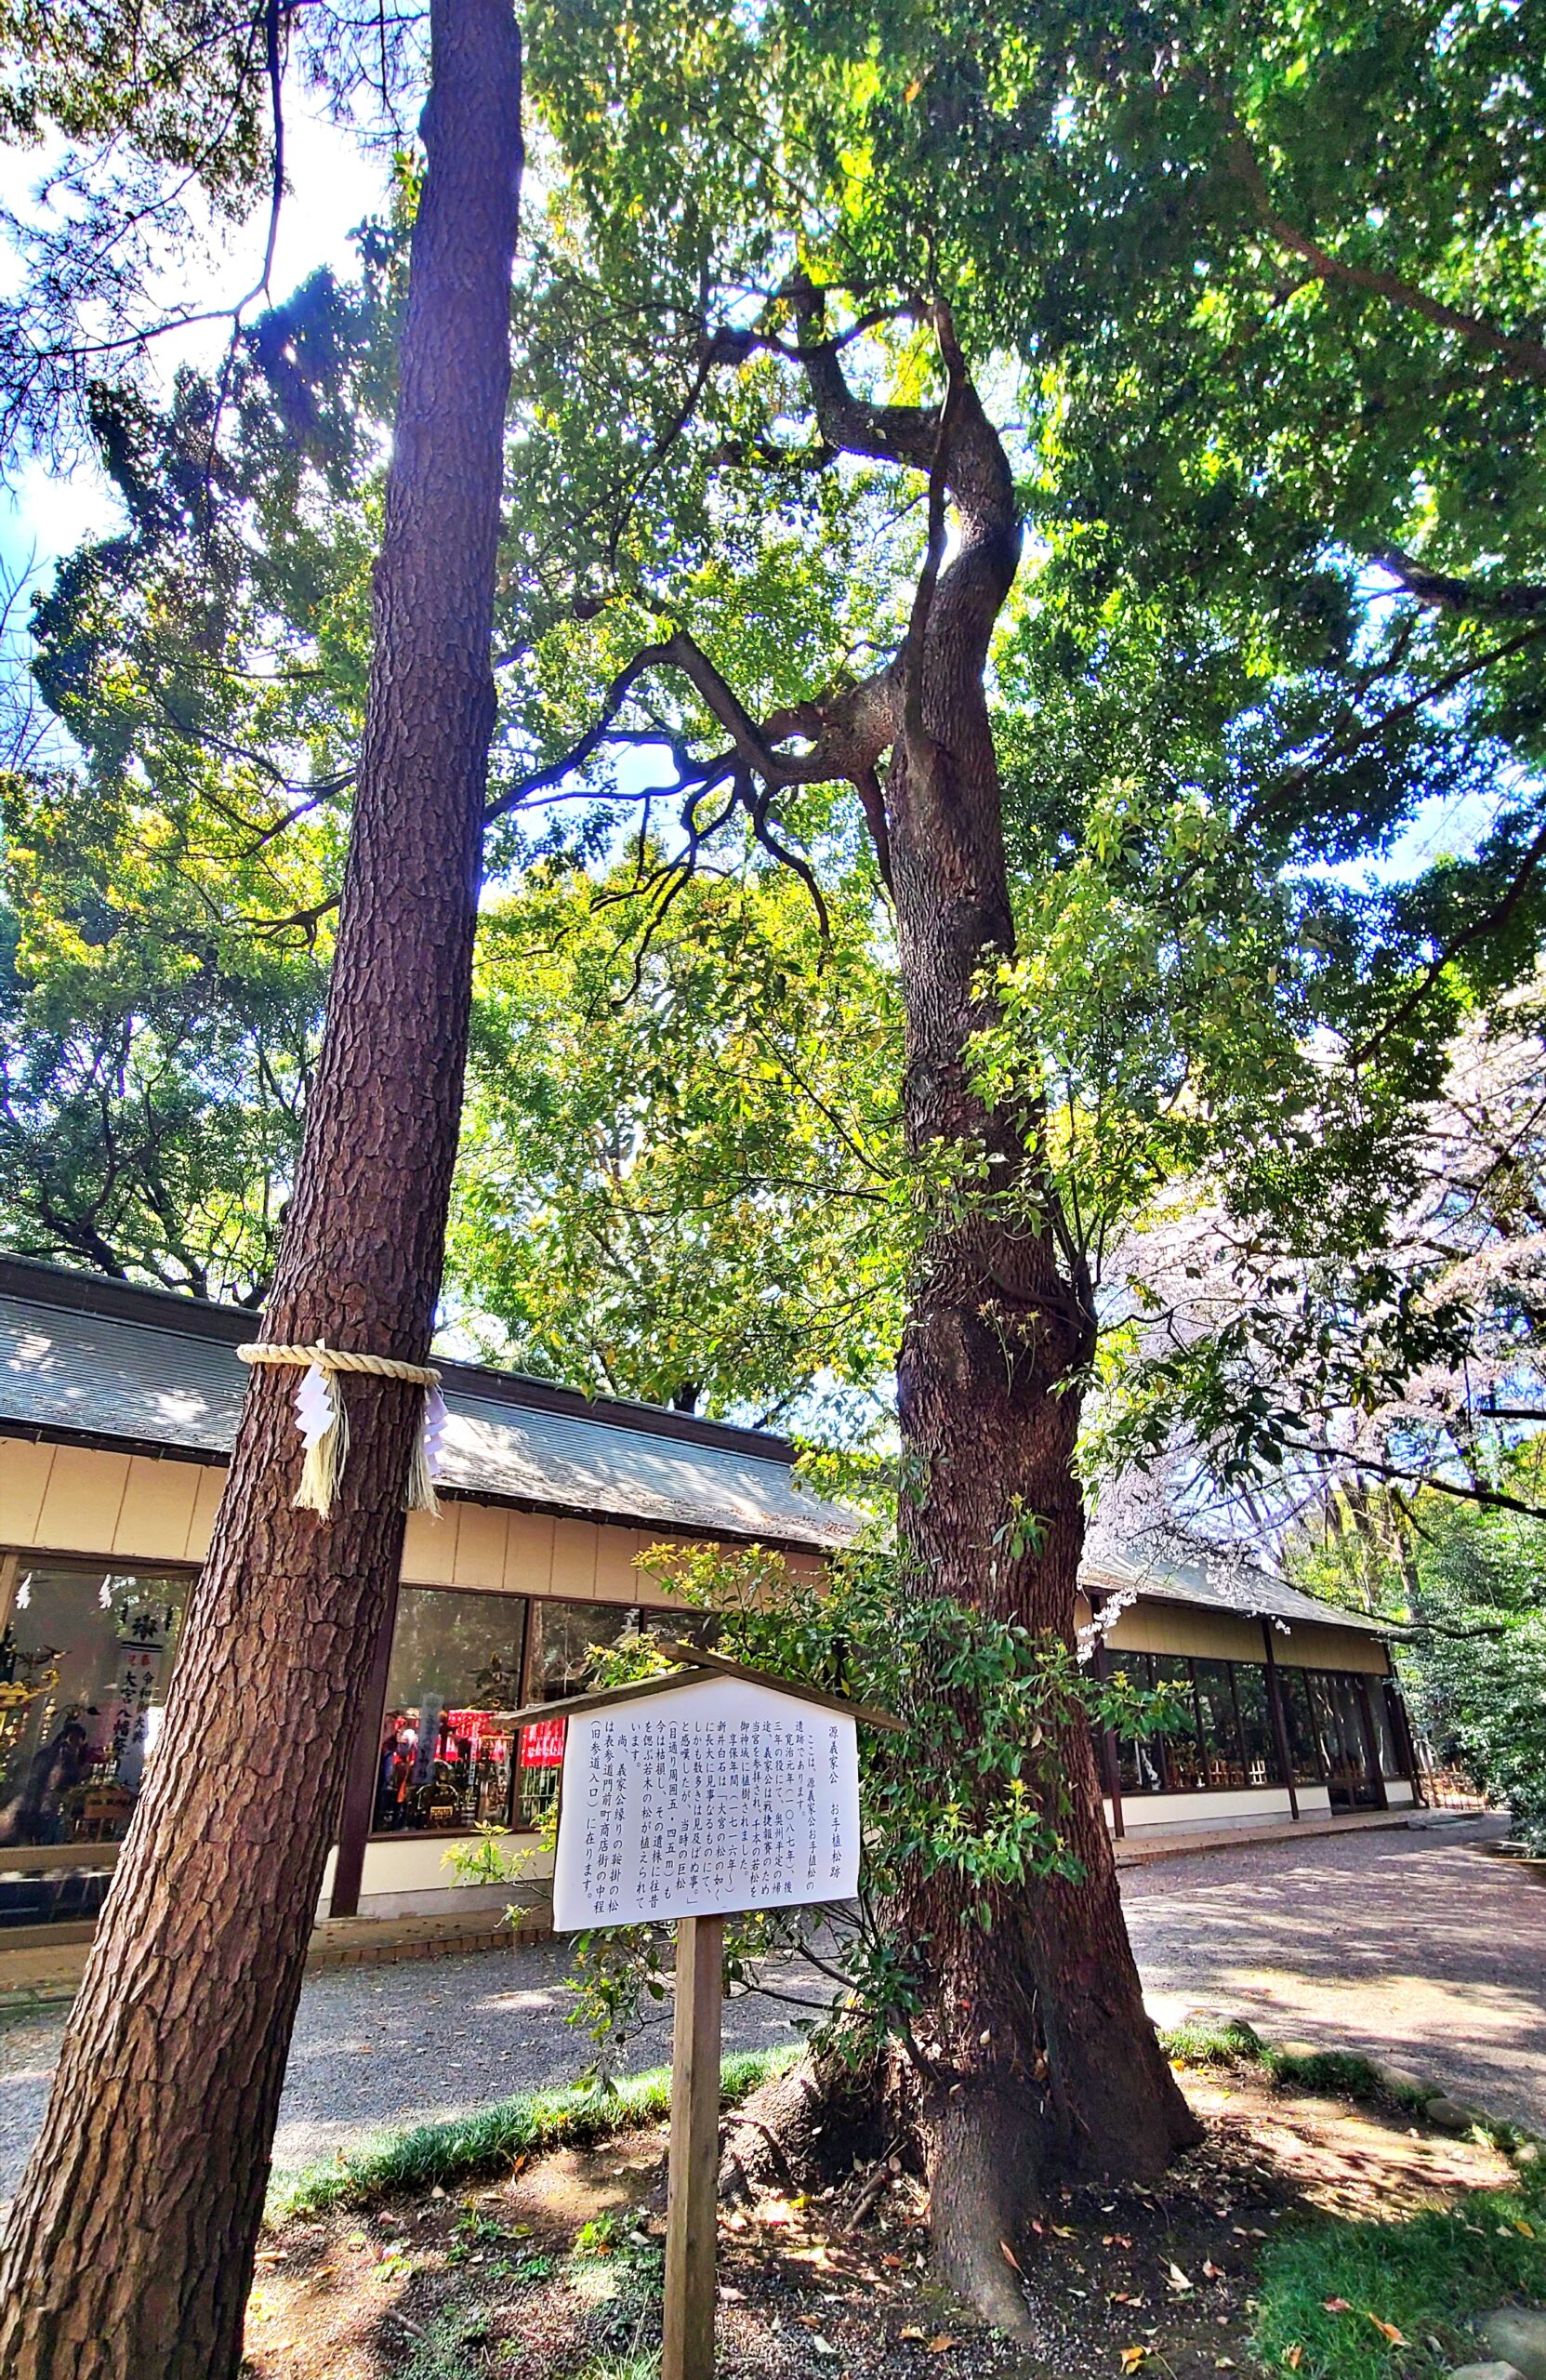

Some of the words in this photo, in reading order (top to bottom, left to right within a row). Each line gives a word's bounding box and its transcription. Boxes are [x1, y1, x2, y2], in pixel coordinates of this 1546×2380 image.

[630, 1723, 641, 1768] います。
[795, 1721, 806, 1817] 遺跡であります。
[828, 1726, 839, 1784] 源義家公
[593, 1722, 614, 1914] は表参道門前町商店街の中程
[636, 1722, 654, 1910] を偲ぶ若木の松が植えられて
[702, 1722, 715, 1894] に長大に見事なるものにて、
[829, 1804, 842, 1879] お手植松跡
